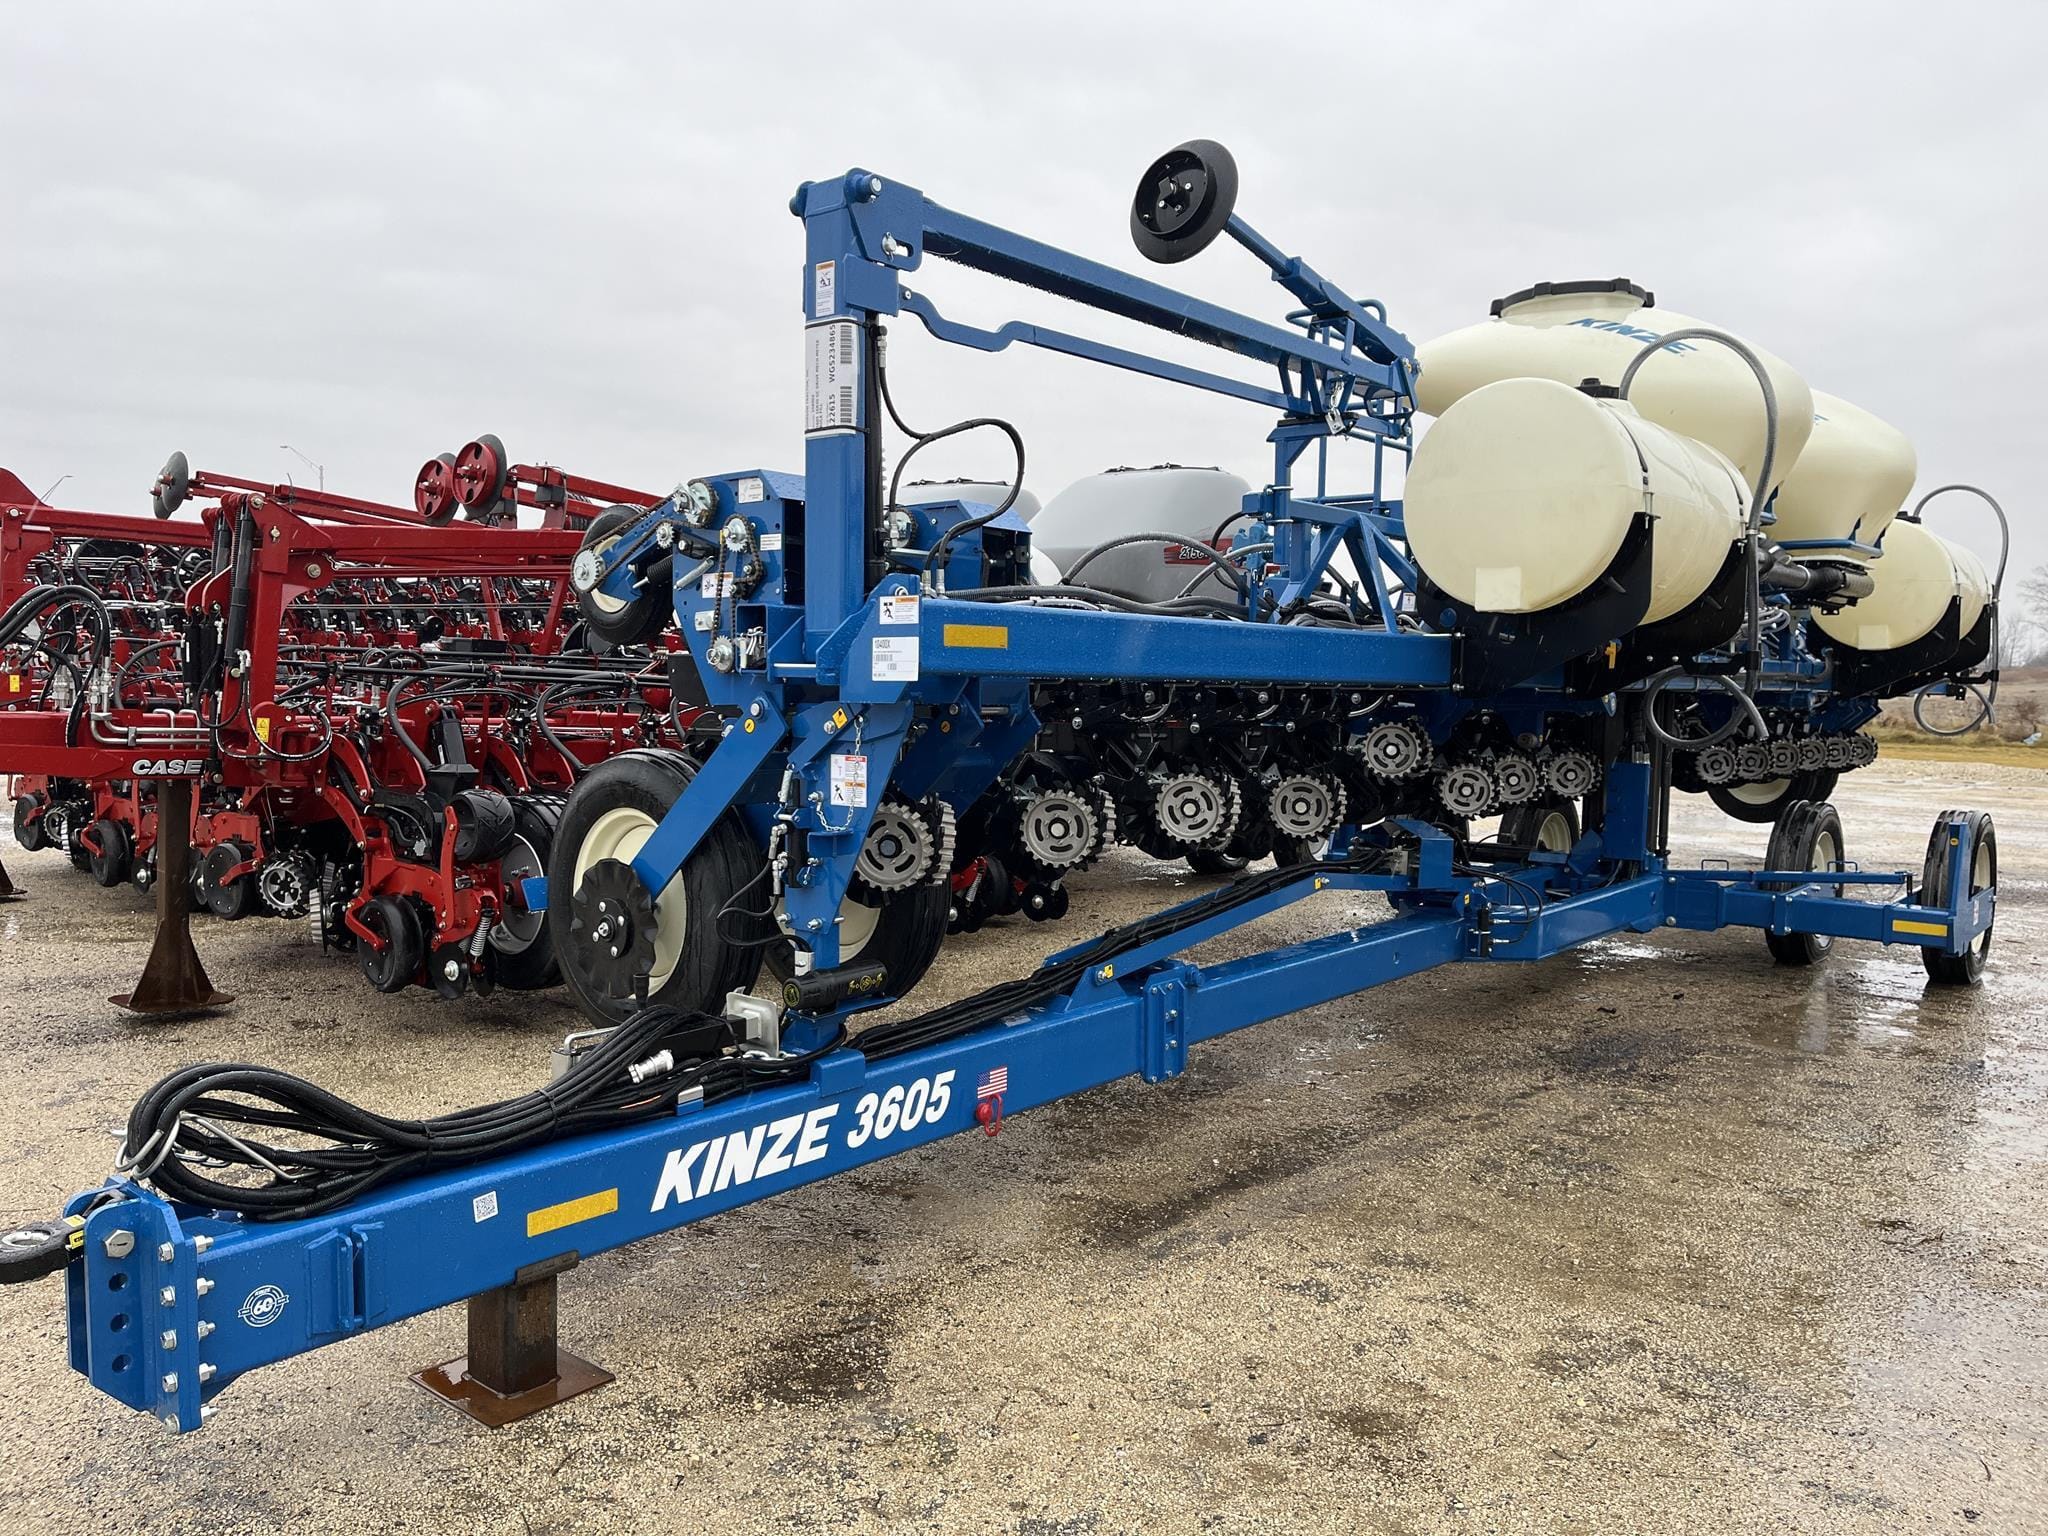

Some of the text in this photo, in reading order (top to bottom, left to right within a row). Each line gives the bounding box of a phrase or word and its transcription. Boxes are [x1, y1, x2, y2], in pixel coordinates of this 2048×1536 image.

[1565, 318, 1699, 354] KINZE
[828, 393, 836, 426] 22615
[132, 759, 203, 775] CASE
[650, 1069, 956, 1213] KINZE 3605
